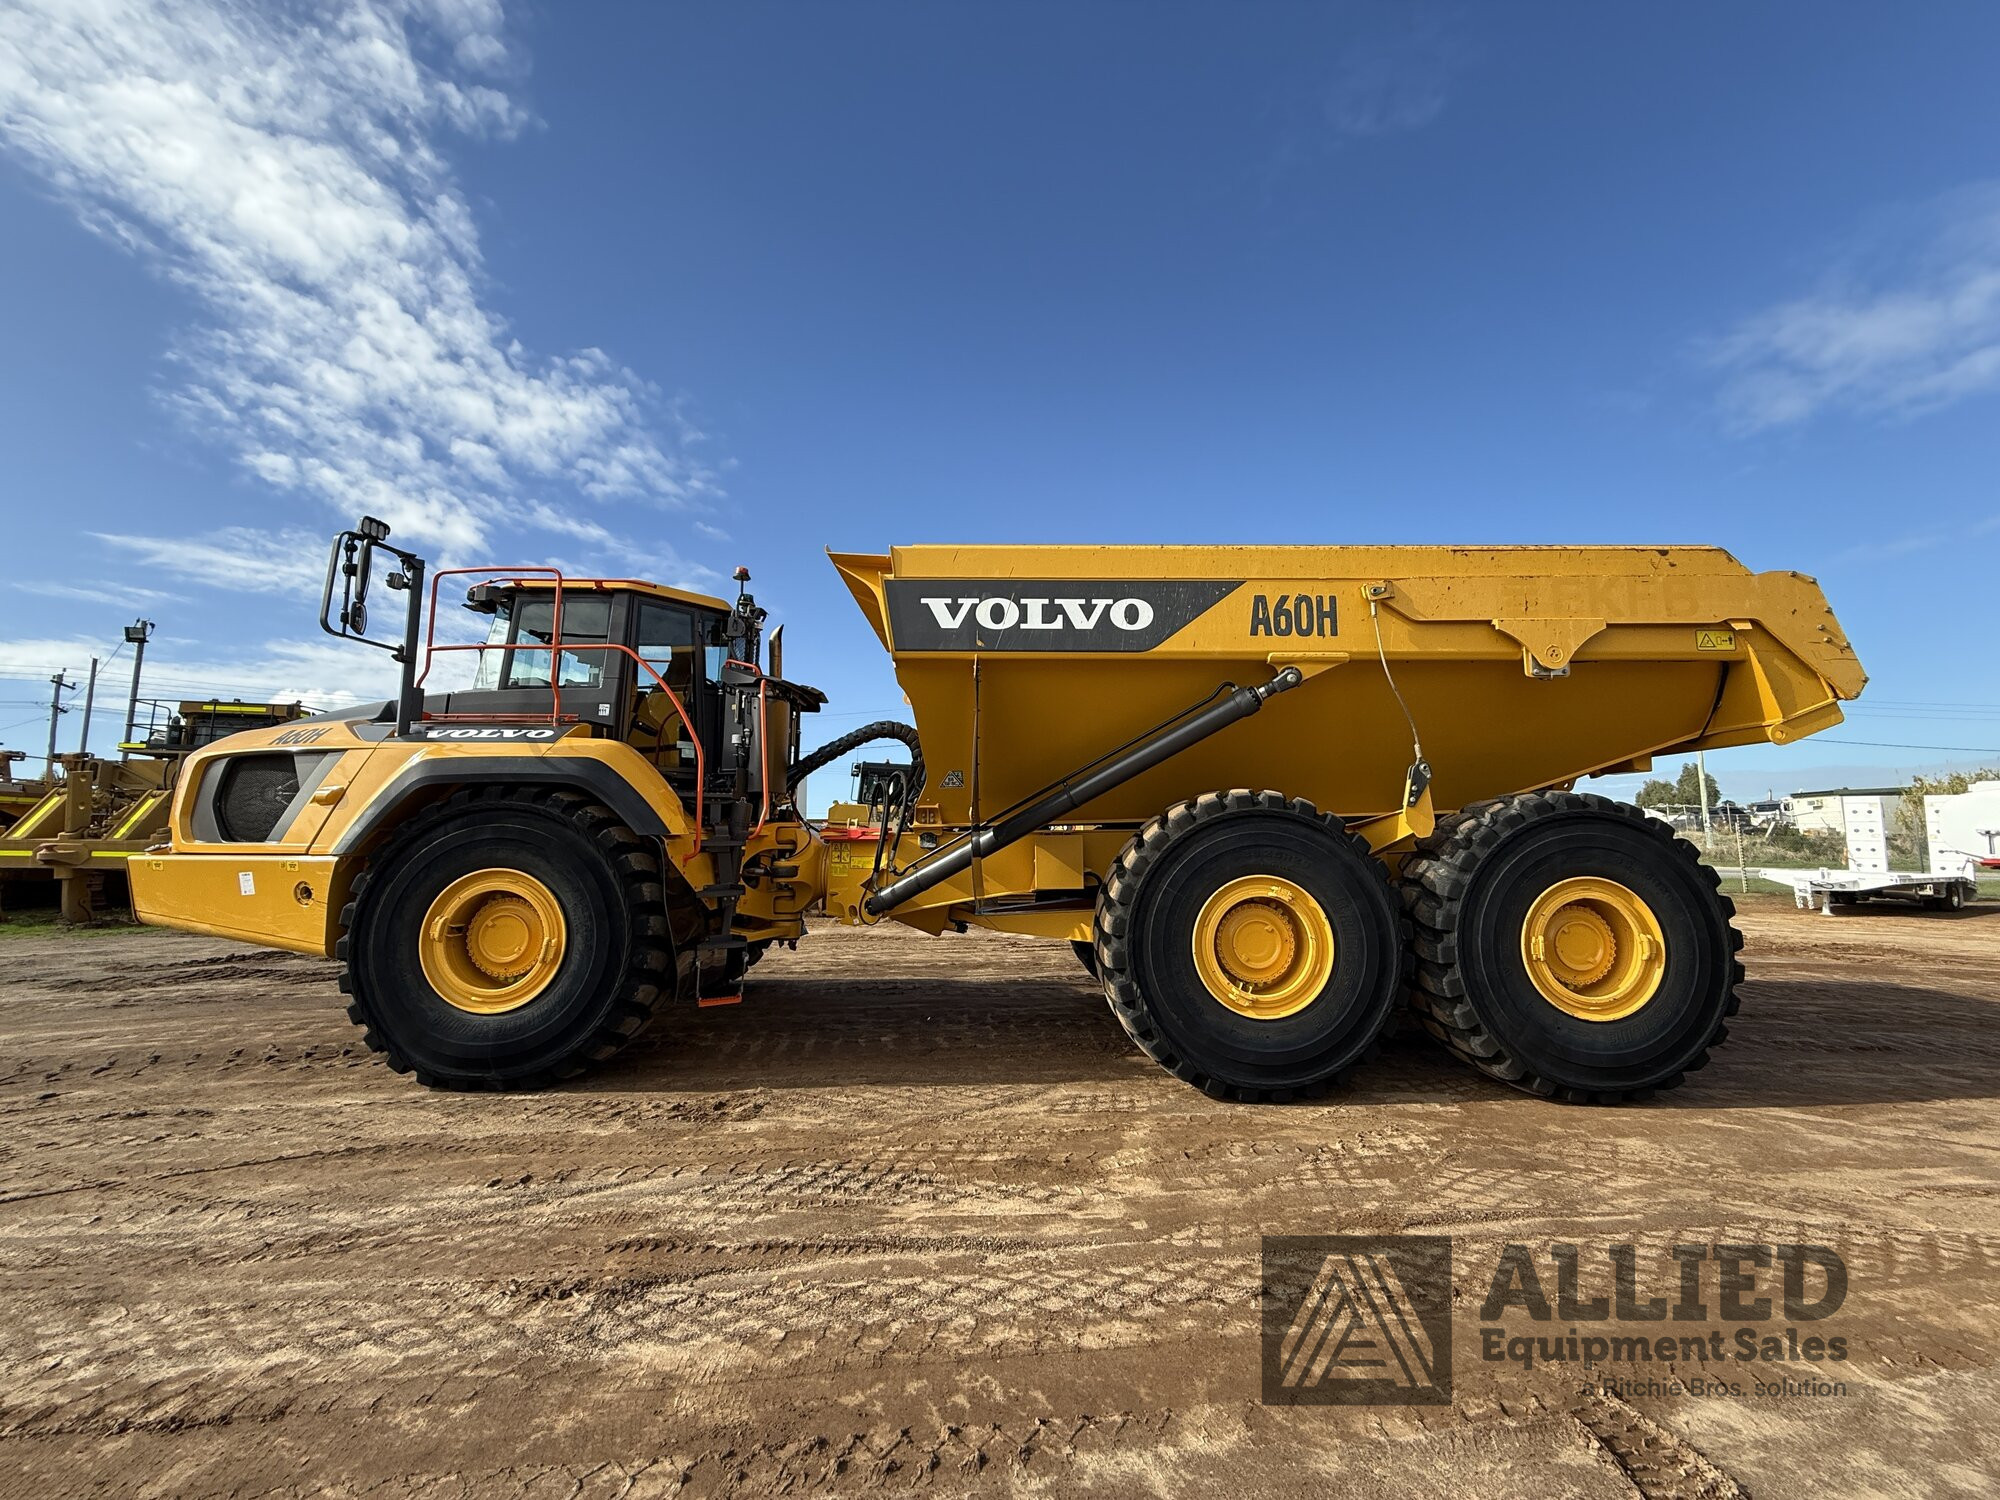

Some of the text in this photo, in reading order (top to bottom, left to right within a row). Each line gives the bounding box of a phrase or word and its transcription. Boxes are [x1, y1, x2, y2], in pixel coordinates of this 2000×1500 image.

[920, 596, 1155, 631] VOLVO
[1249, 594, 1338, 637] A60H
[268, 727, 333, 745] A60H
[425, 729, 555, 739] VOLVO
